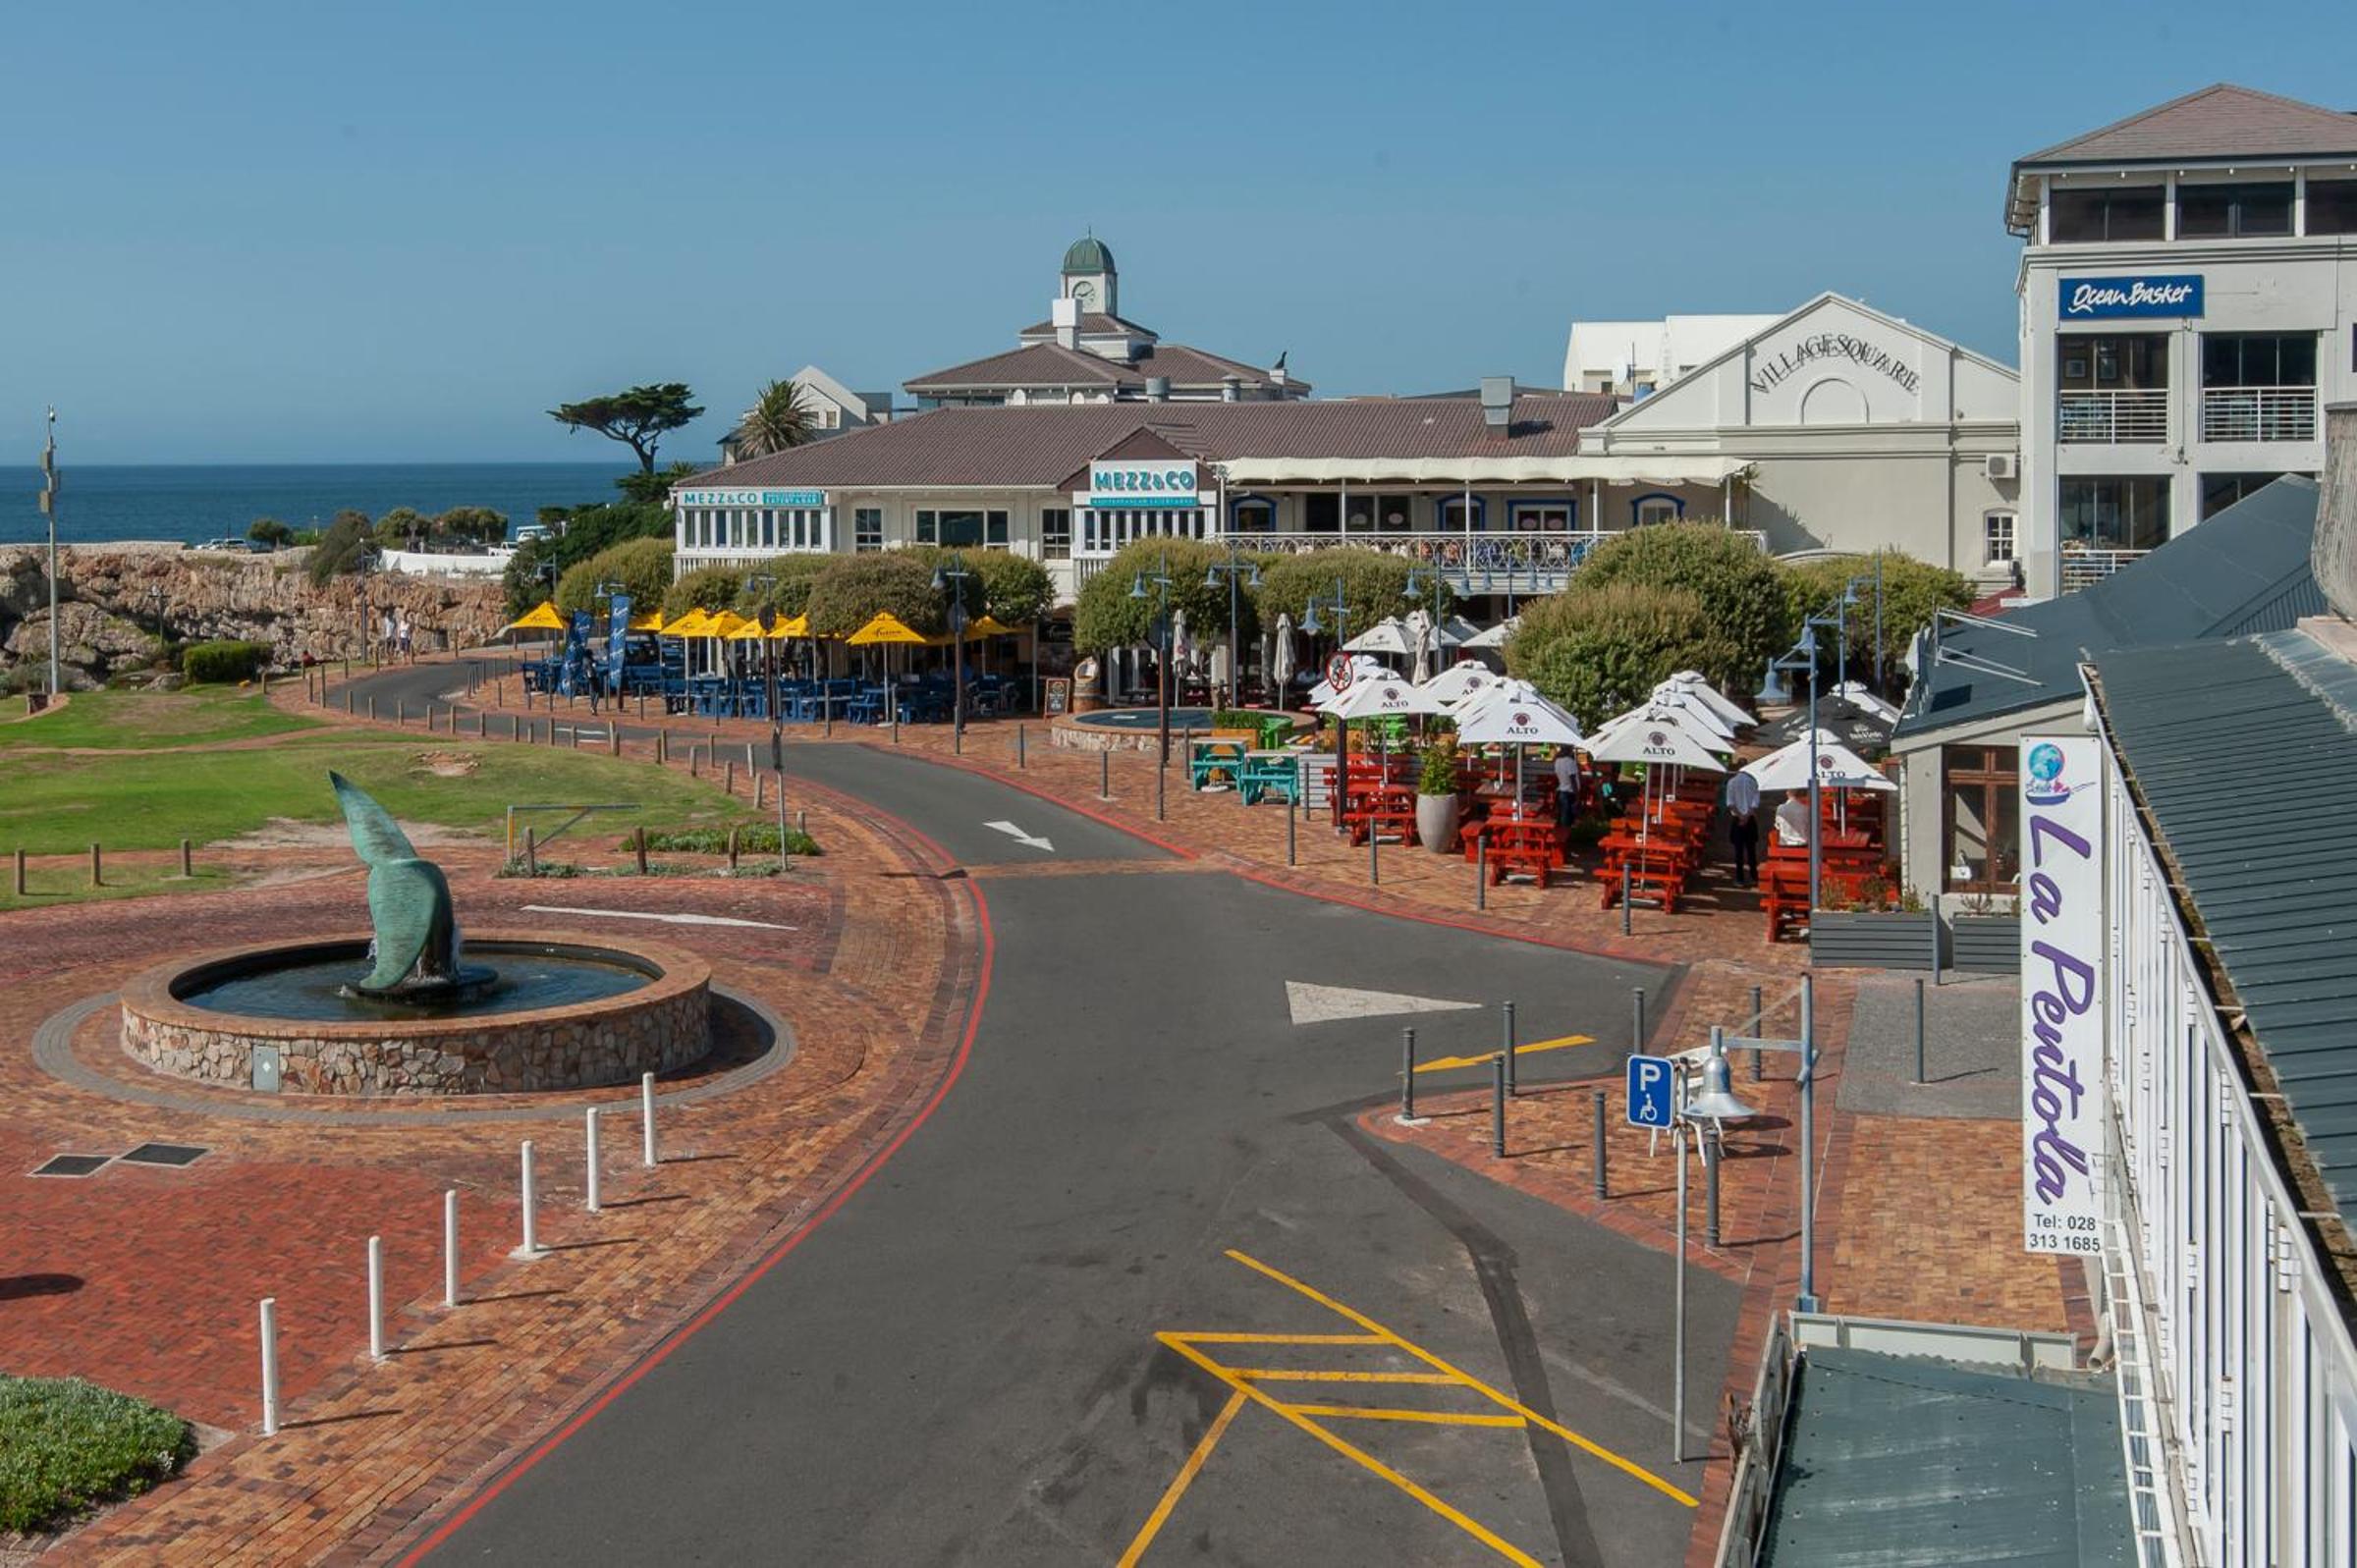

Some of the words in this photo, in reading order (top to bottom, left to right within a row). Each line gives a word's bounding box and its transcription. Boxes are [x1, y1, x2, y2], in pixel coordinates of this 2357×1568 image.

[2068, 284, 2128, 313] Ocean
[2128, 282, 2193, 306] Basket
[1750, 334, 1835, 395] VILLAGE
[1836, 334, 1922, 395] SQUARE
[1094, 470, 1195, 491] MEZZ&CO
[684, 492, 757, 504] MEZZ&CO
[1380, 700, 1409, 709] ALTO
[1506, 726, 1539, 735] ALTO
[1642, 746, 1675, 756] ALTO
[2029, 815, 2091, 925] La
[1639, 1062, 1662, 1092] P
[2032, 941, 2095, 1207] Pentola
[2033, 1214, 2061, 1228] Tel:
[2067, 1216, 2096, 1230] 028
[2029, 1233, 2057, 1248] 313
[2064, 1236, 2101, 1252] 1685
